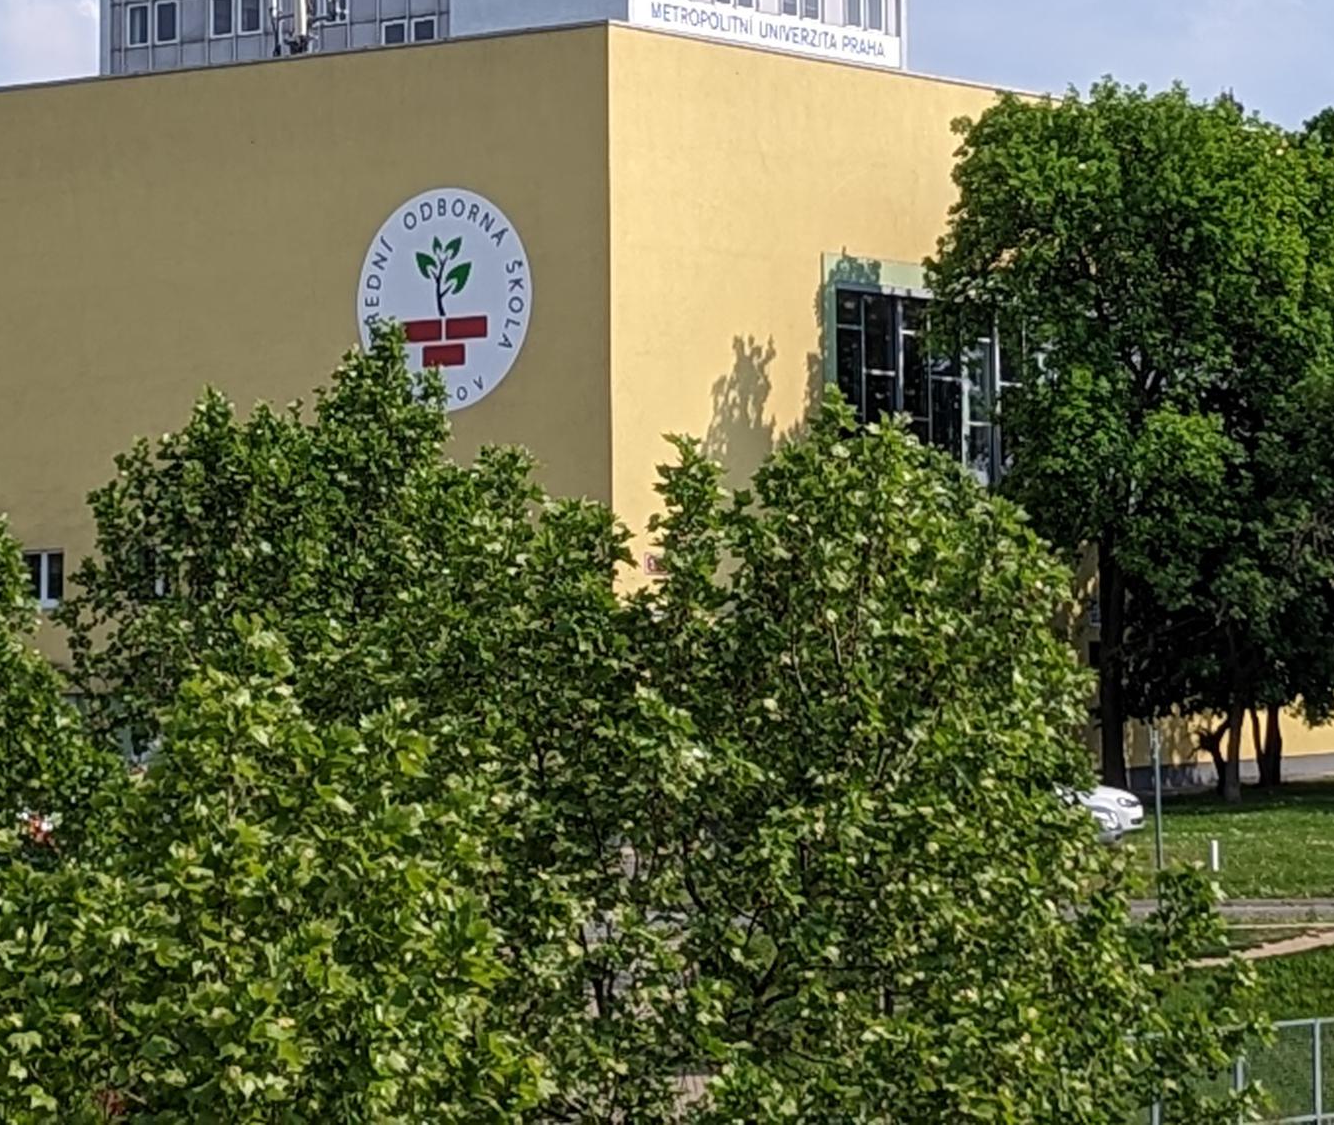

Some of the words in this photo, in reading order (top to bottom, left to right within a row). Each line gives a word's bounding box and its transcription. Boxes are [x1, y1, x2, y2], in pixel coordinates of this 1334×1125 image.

[650, 1, 754, 35] METROPOLITNÍ
[759, 20, 837, 50] UNIVERZITA
[842, 35, 886, 58] PRAHA
[403, 197, 509, 247] ODBORNÁ
[498, 259, 525, 349] ŠKOLA
